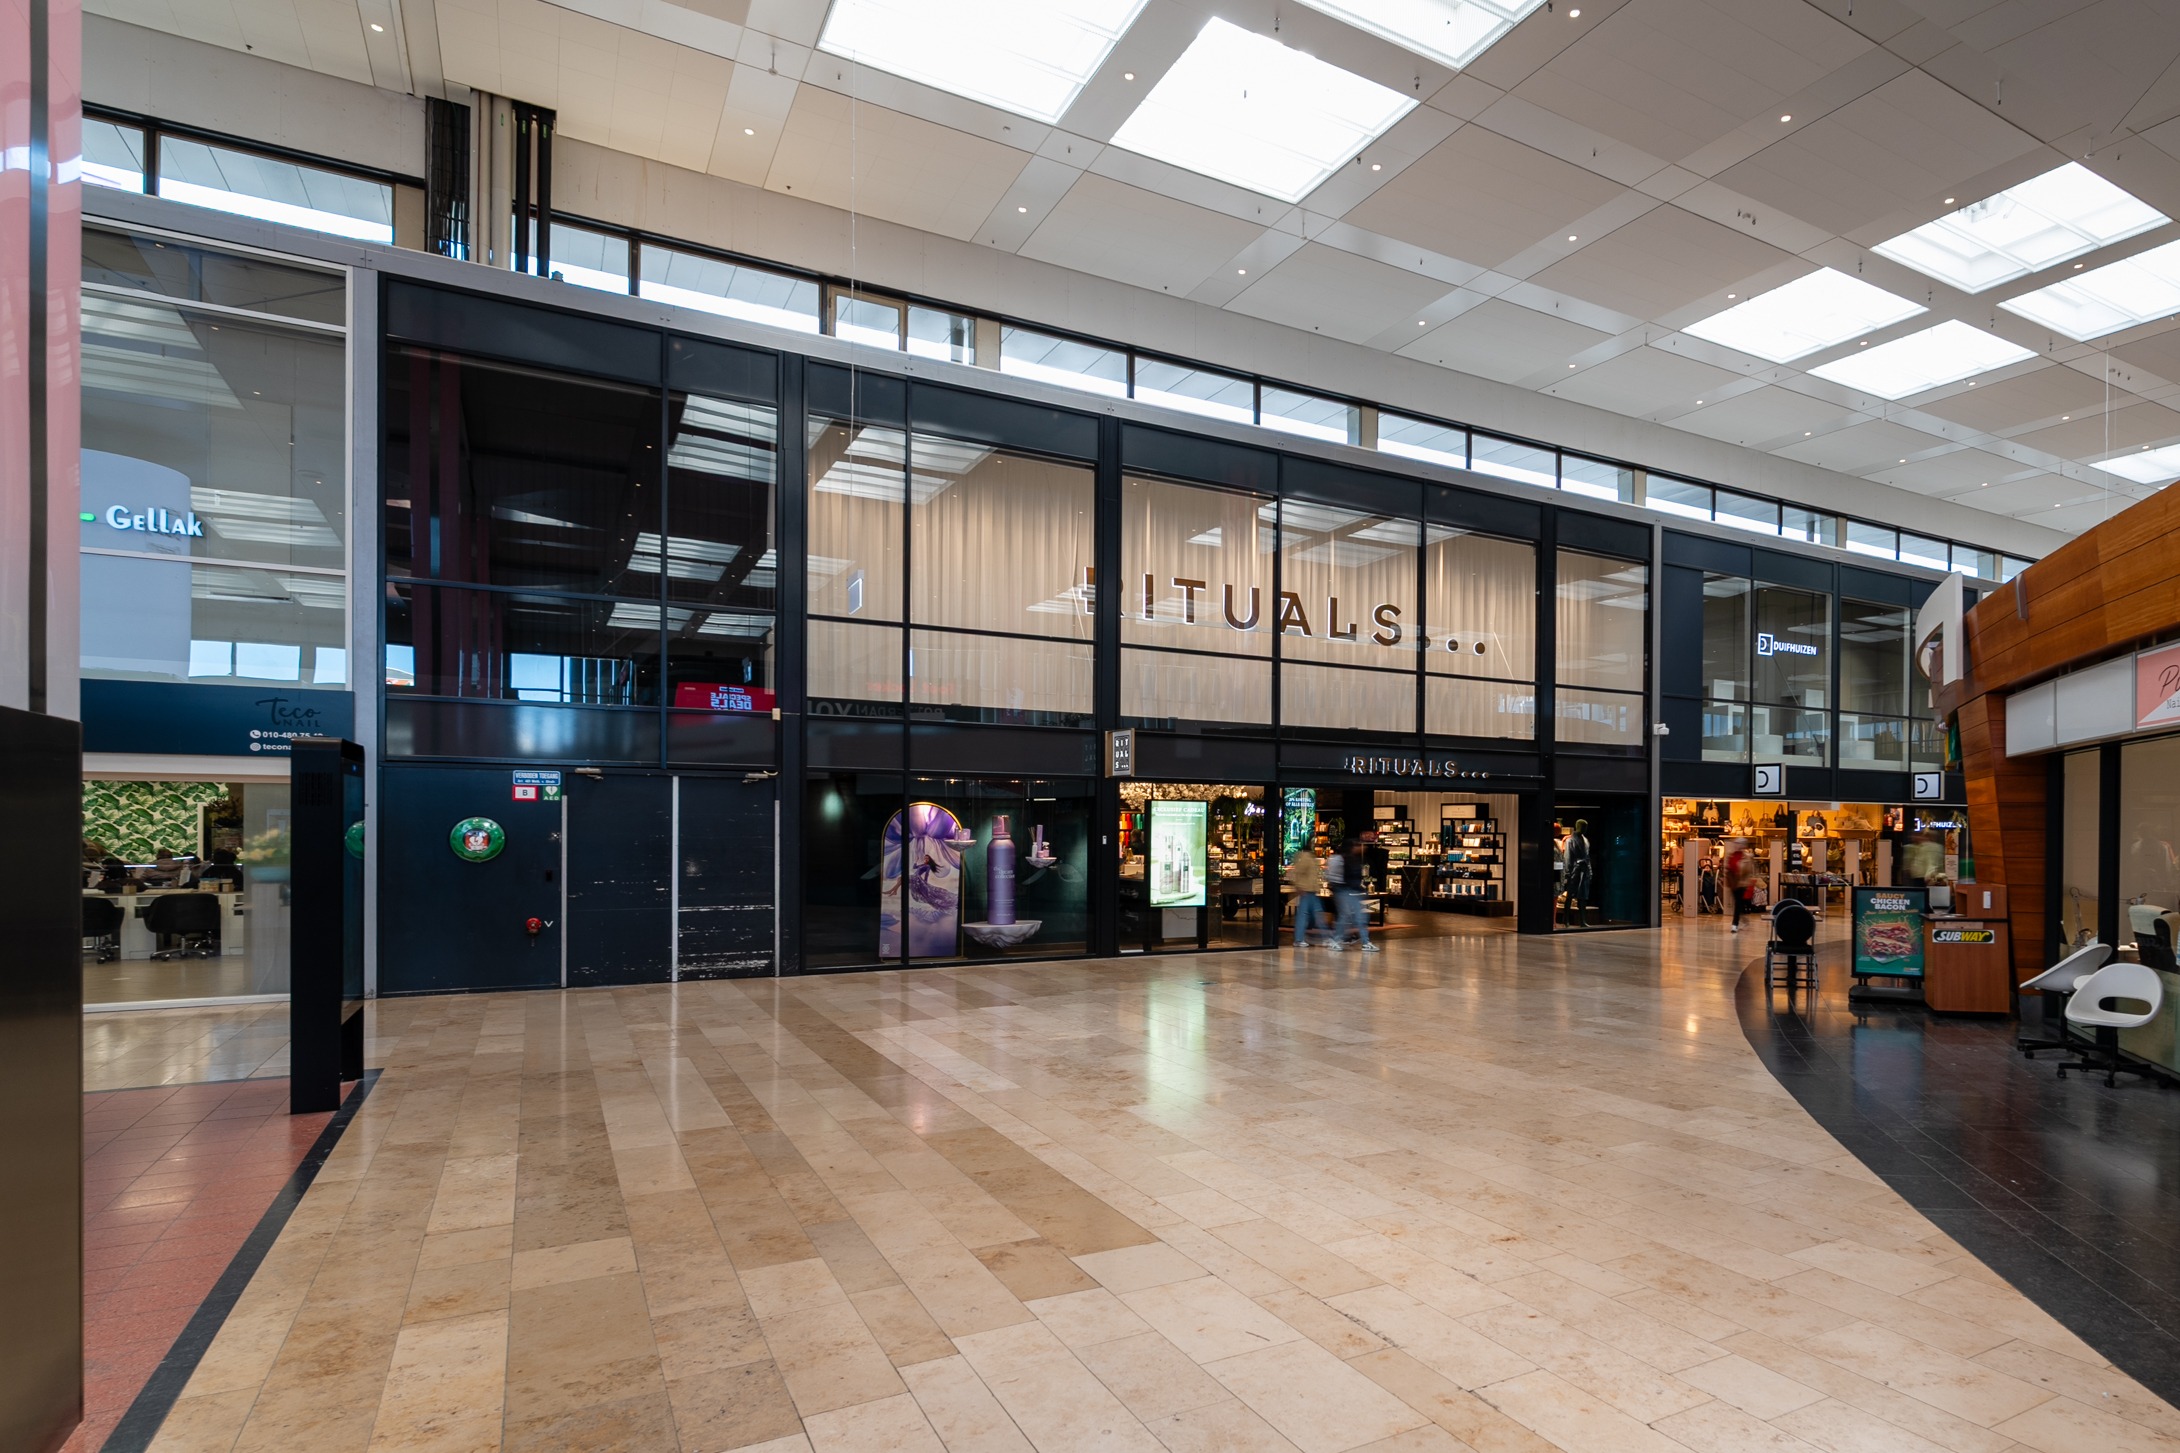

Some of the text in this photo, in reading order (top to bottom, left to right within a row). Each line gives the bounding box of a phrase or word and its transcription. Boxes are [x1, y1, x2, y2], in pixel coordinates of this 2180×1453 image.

[1773, 641, 1817, 655] DUIFHUIZEN
[255, 697, 321, 726] Teco
[1937, 931, 1990, 942] SUBWAY
